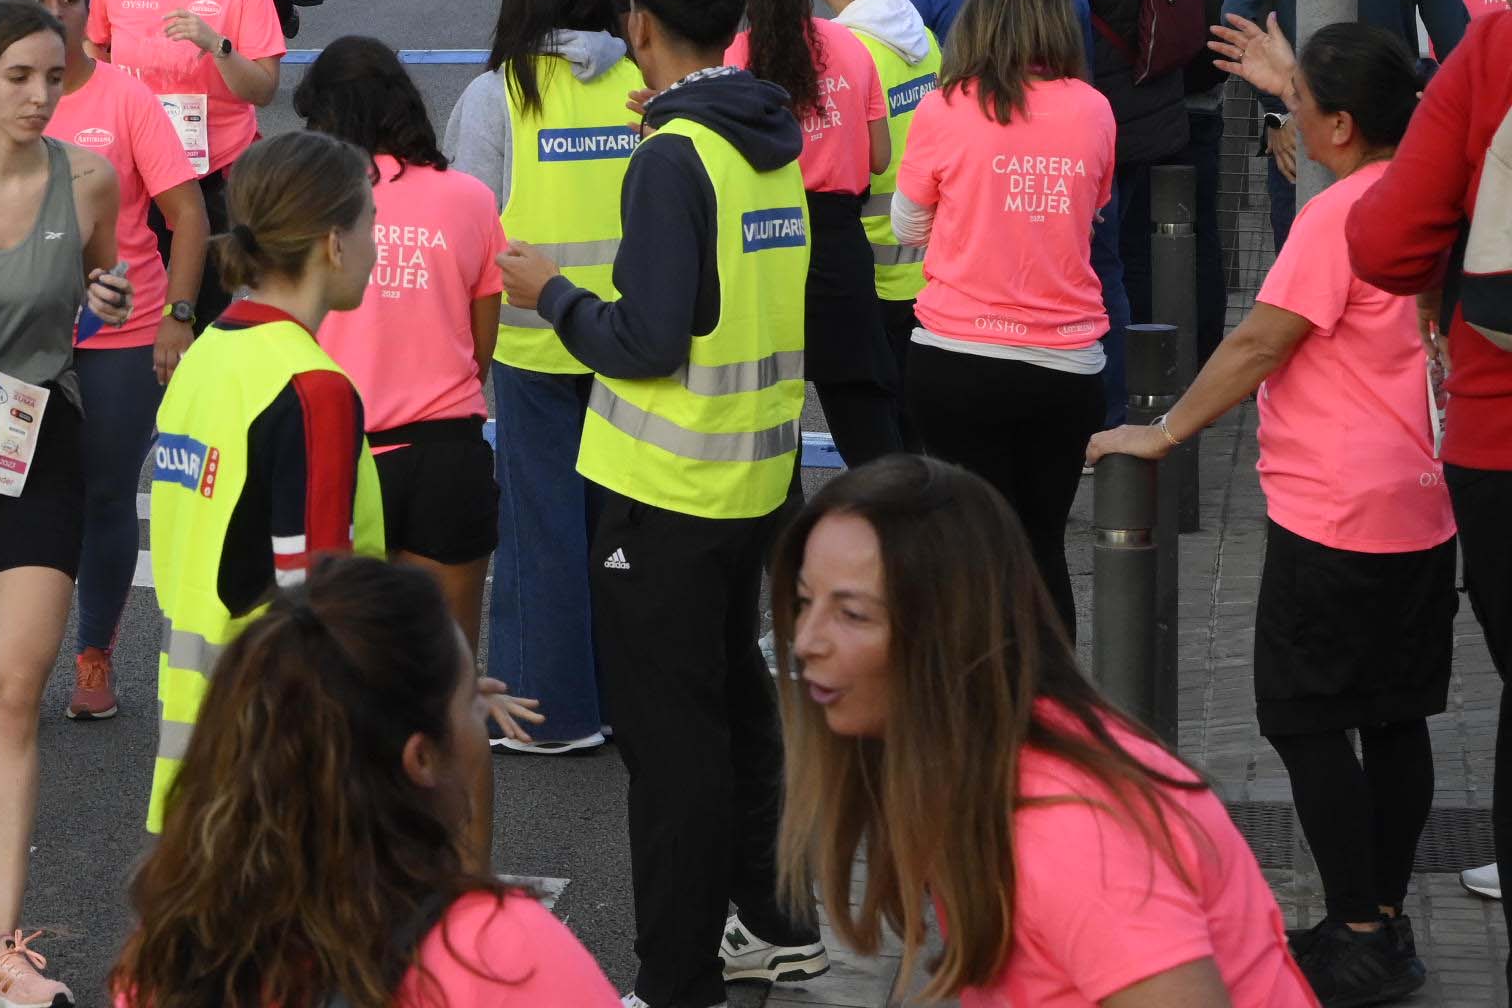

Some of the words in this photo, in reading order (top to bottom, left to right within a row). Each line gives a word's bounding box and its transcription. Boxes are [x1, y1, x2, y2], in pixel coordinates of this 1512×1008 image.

[992, 155, 1086, 176] CARRERA
[1010, 175, 1034, 189] DE
[1043, 177, 1068, 194] LA
[1004, 195, 1071, 214] MUJER
[397, 250, 426, 268] LA
[974, 317, 1028, 336] OYSHO
[604, 560, 631, 570] adidas
